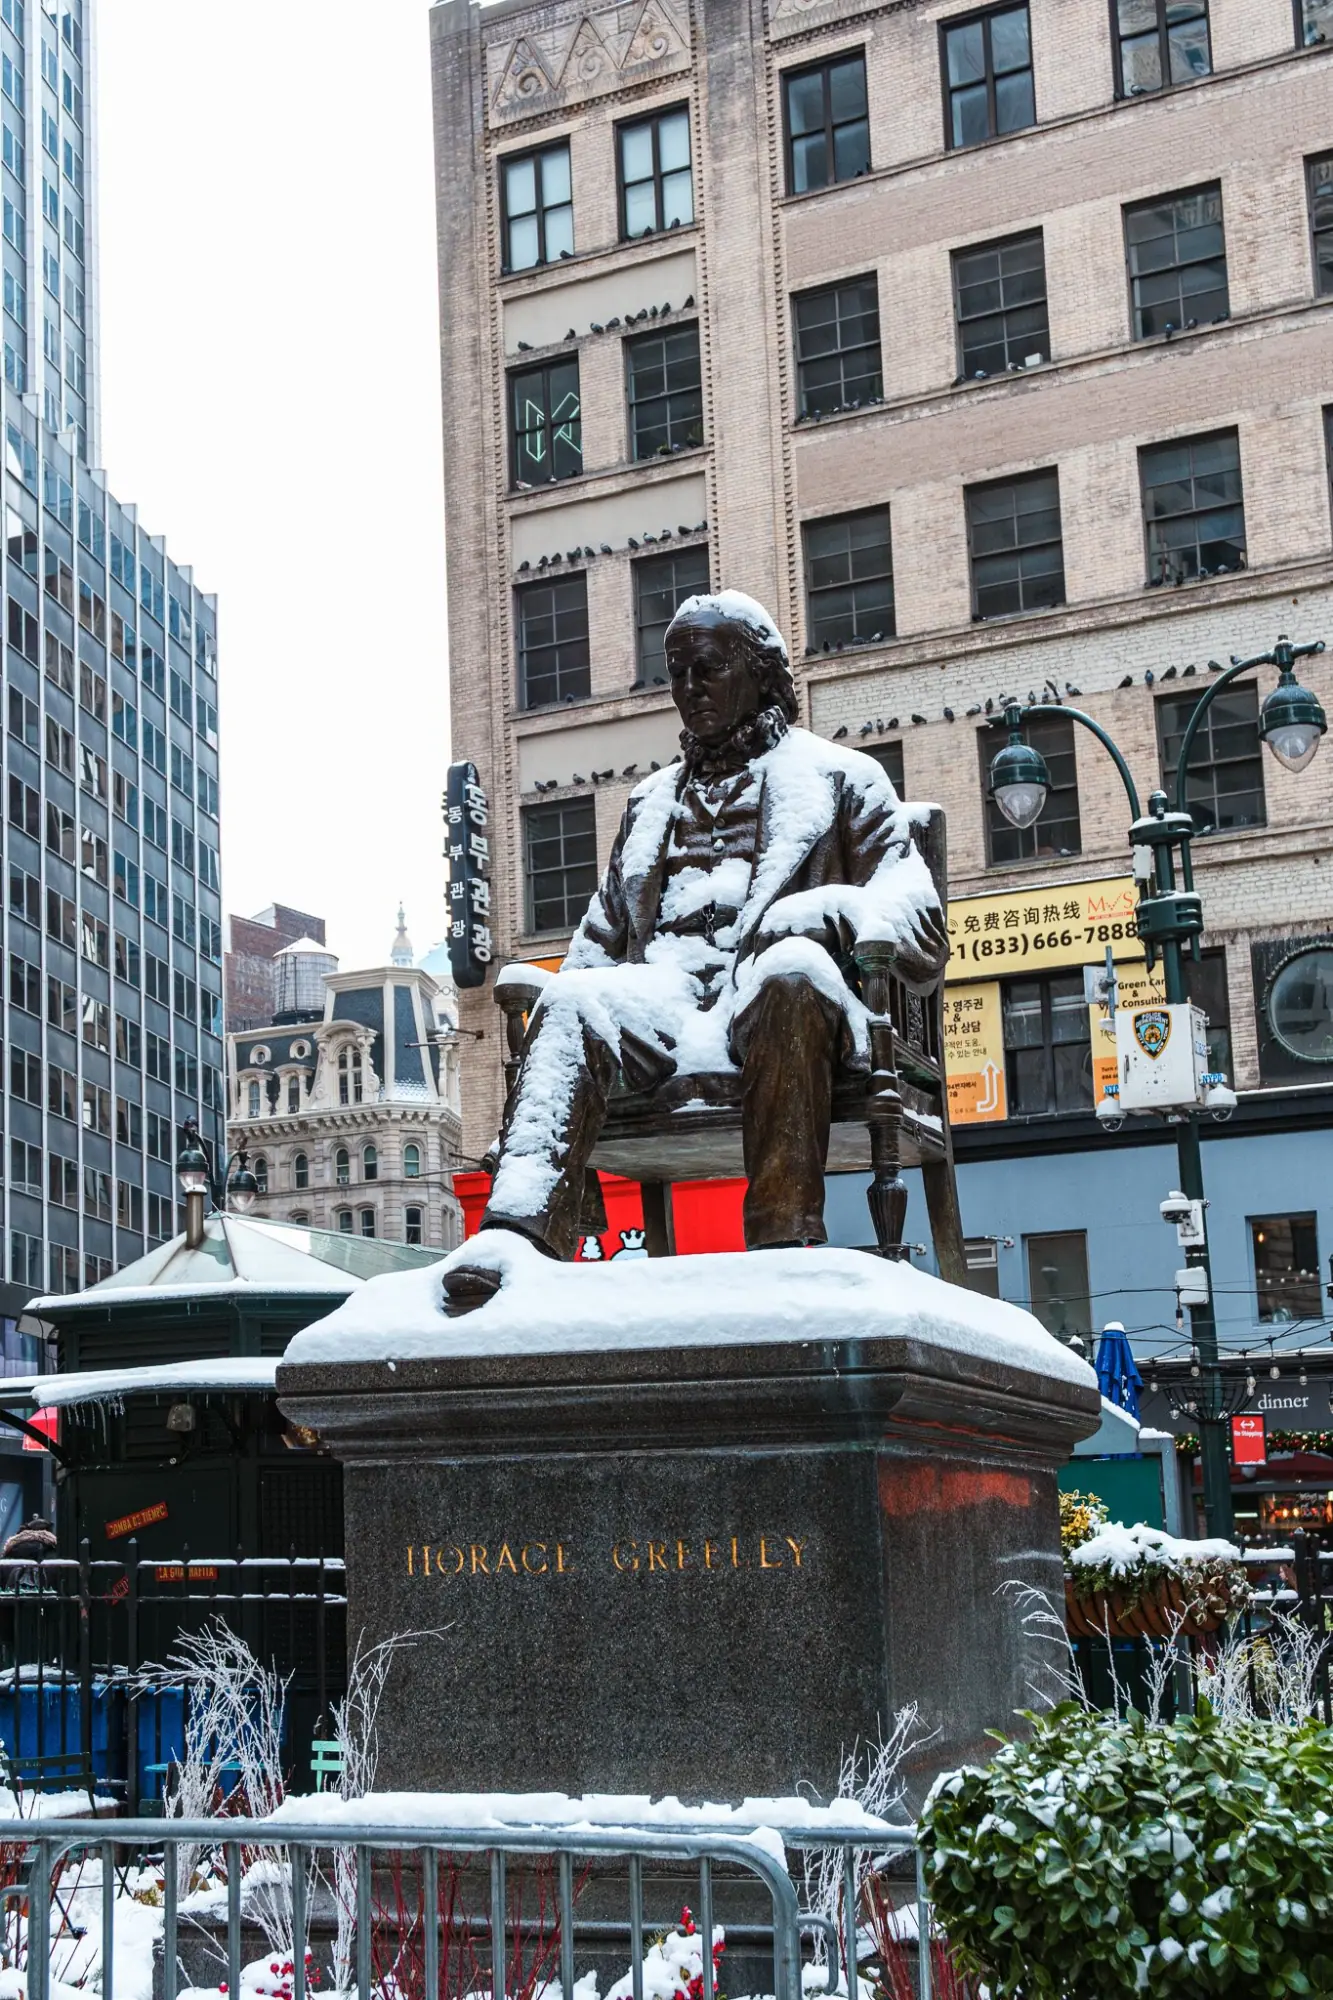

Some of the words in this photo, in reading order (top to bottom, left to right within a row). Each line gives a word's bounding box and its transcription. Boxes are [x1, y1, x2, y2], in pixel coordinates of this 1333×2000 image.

[448, 807, 466, 938] 동부관광
[465, 784, 492, 966] 동부관광
[964, 900, 1081, 934] 免费咨询热线
[1118, 979, 1146, 990] Green
[1132, 989, 1139, 998] &
[953, 997, 984, 1013] 영주권
[953, 1013, 962, 1023] &
[961, 1020, 981, 1034] 상담
[1202, 1074, 1222, 1084] NYPD
[1258, 1393, 1309, 1409] dinner
[406, 1541, 576, 1577] HORACE
[612, 1536, 807, 1573] GREELEY
